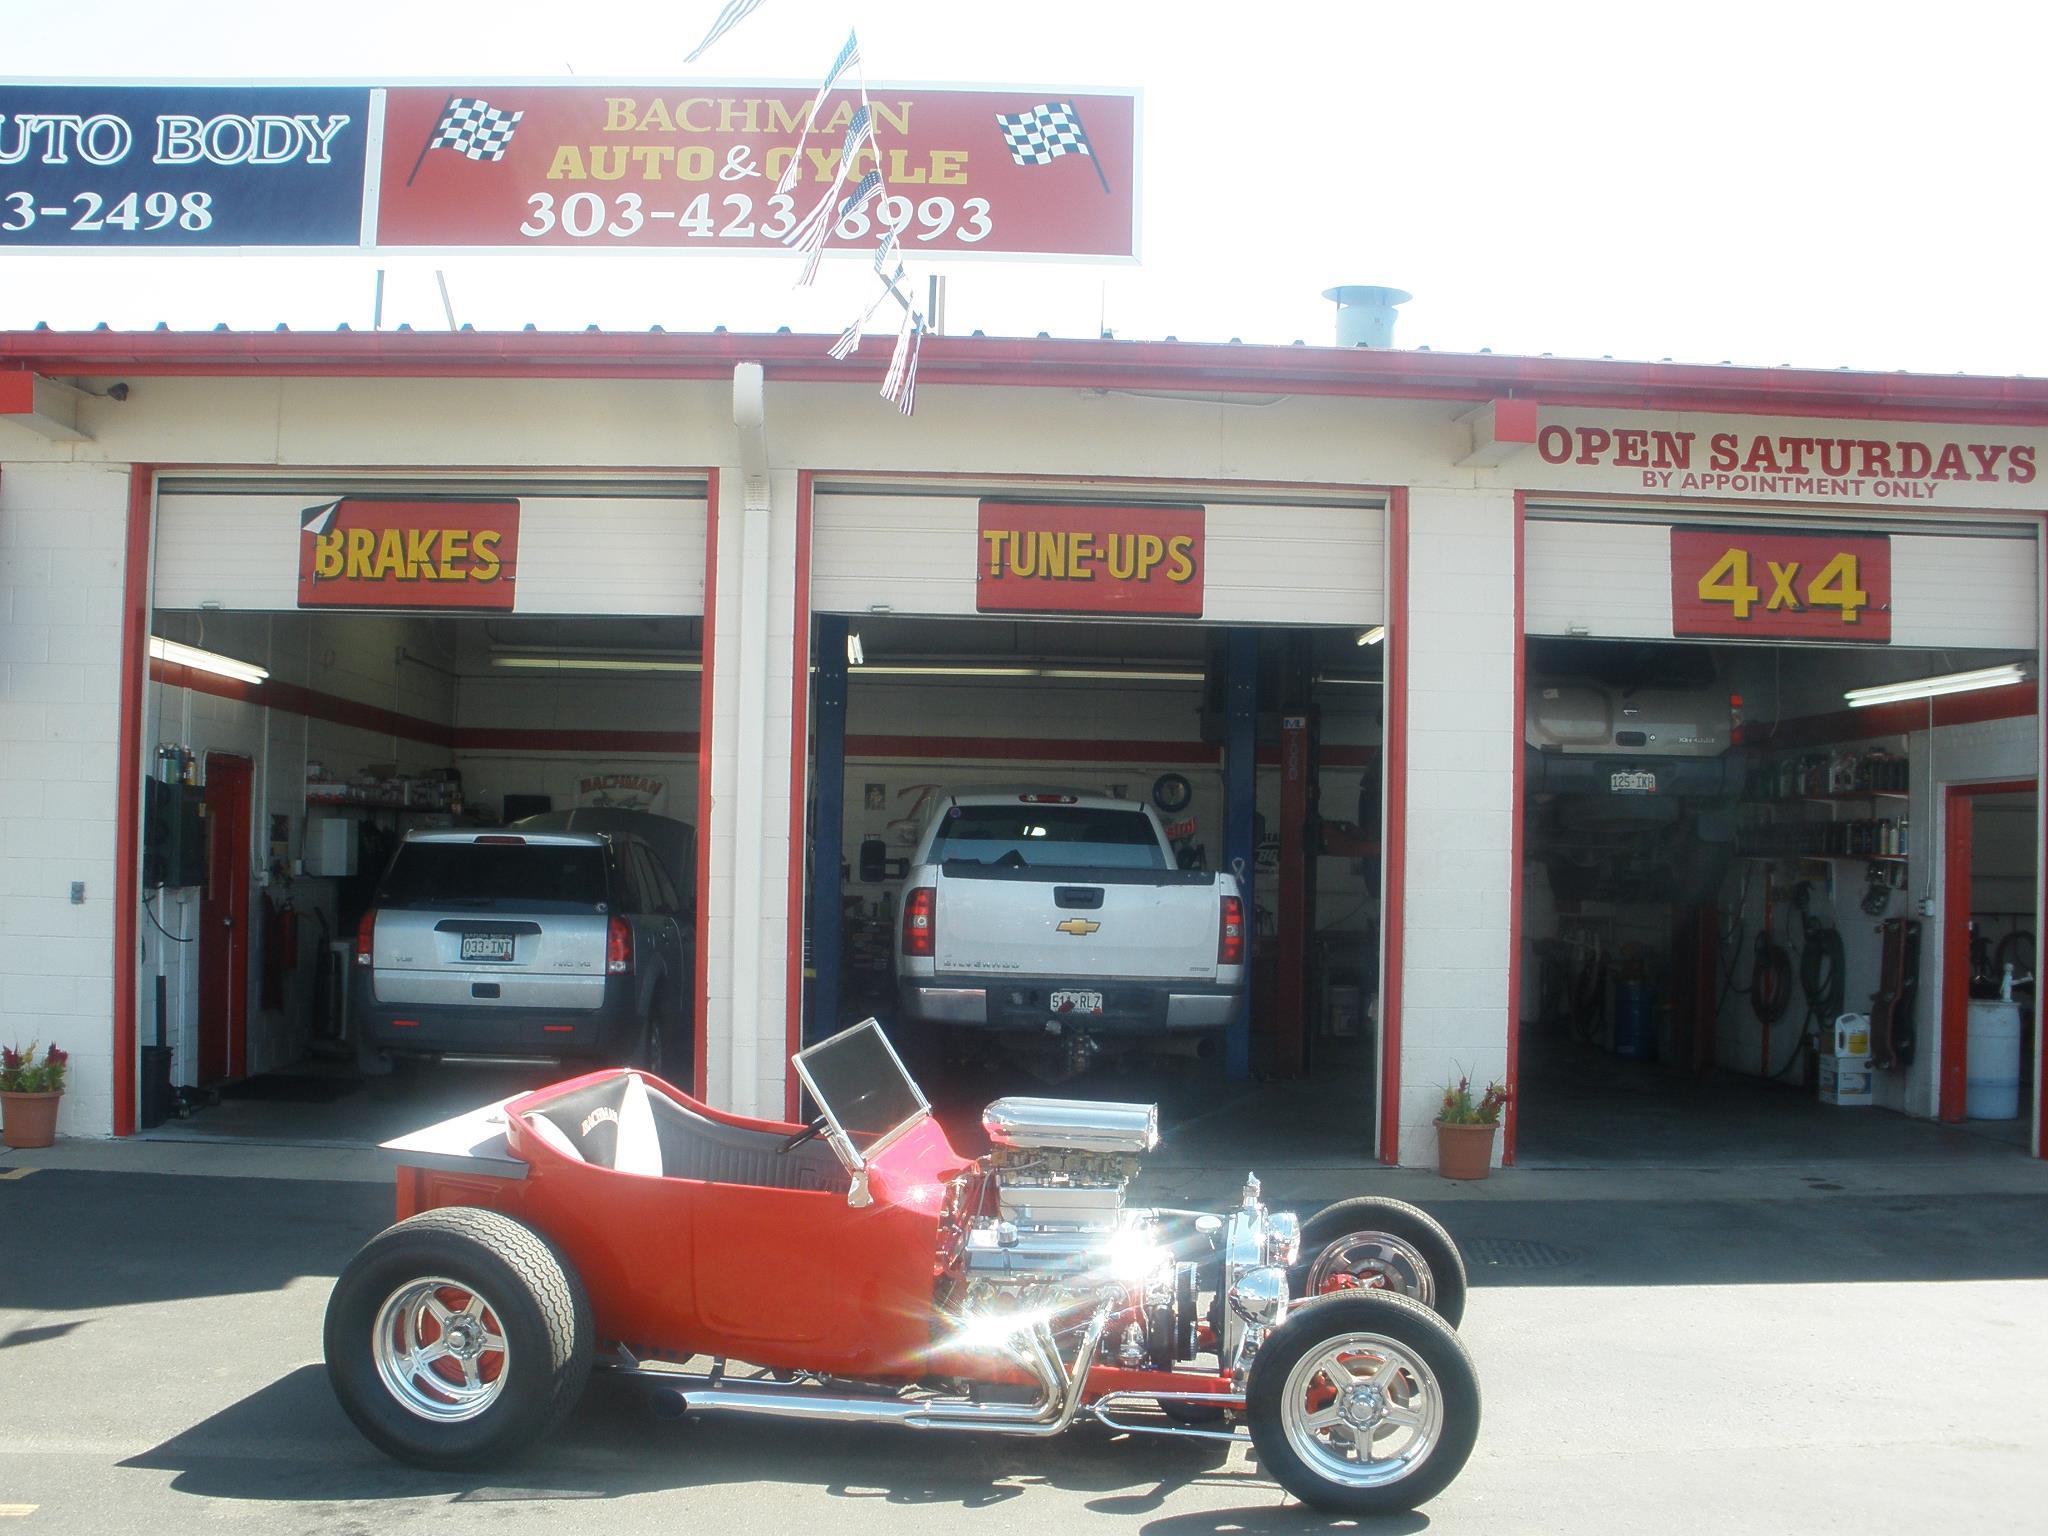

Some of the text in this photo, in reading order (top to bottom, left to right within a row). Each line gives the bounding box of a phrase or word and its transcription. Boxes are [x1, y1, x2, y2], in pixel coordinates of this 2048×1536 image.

[153, 114, 350, 165] BODY
[602, 96, 914, 135] BACHMAN
[520, 192, 993, 242] 303-4238993
[1538, 424, 2037, 484] OPEN SATURDAYS
[1642, 470, 1938, 499] BY APPOINTMENT ONLY
[315, 527, 502, 582] BRAKES
[983, 529, 1194, 583] TUNE-UPS
